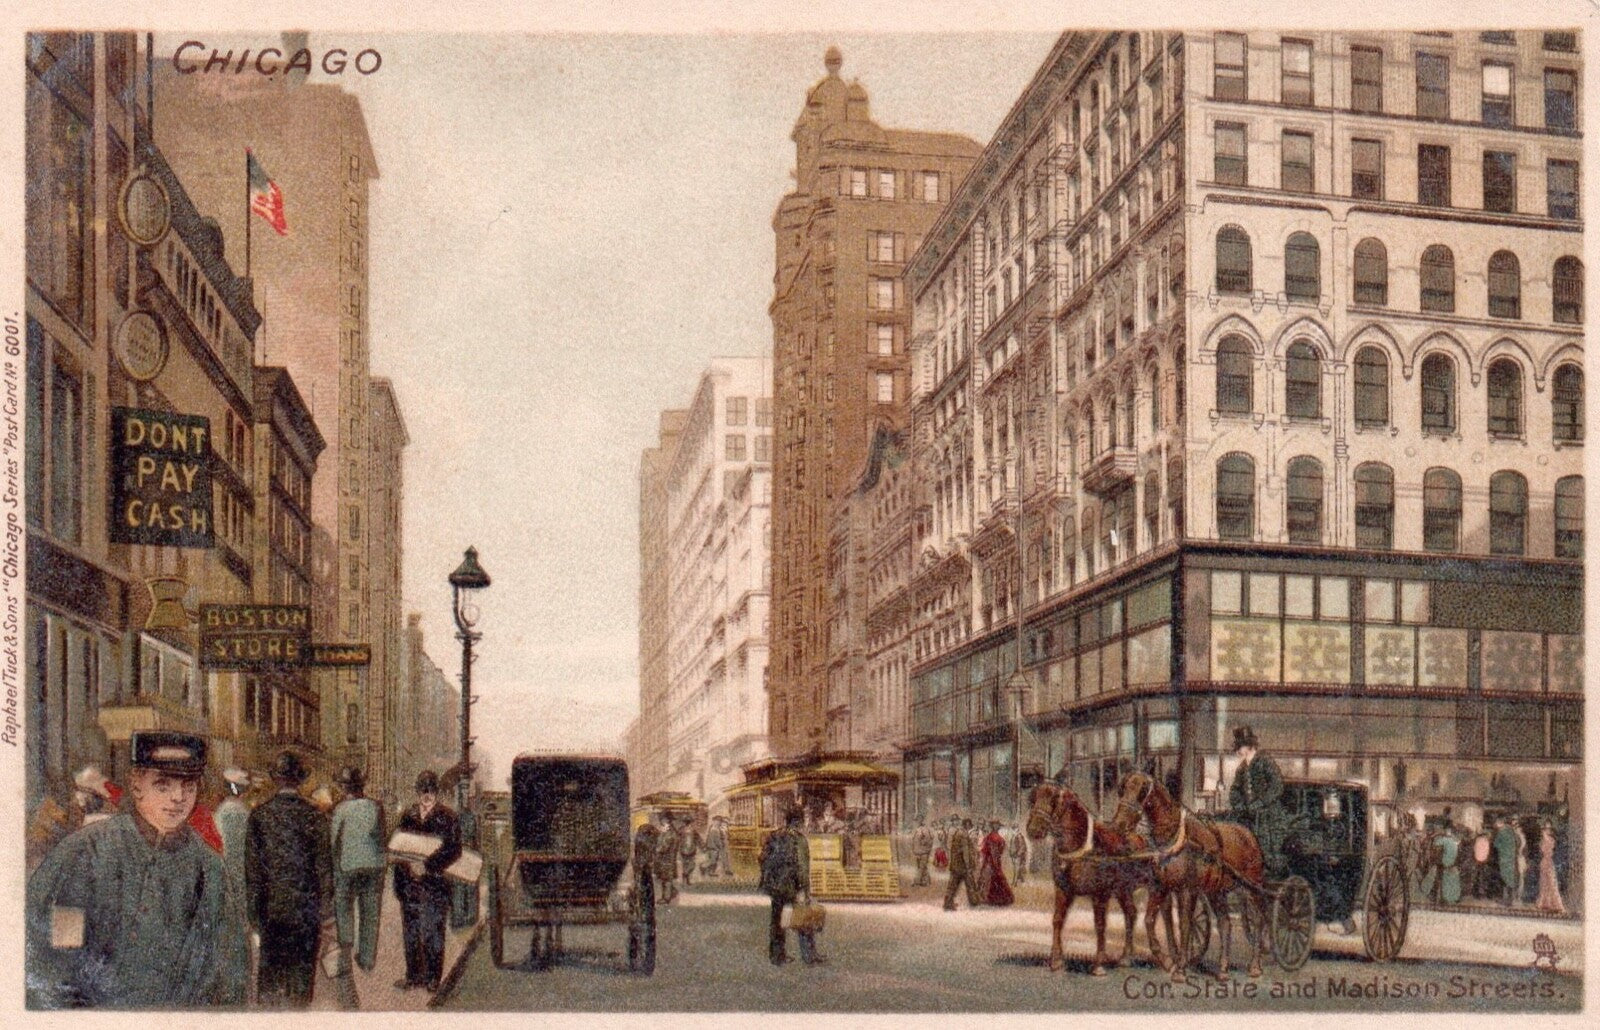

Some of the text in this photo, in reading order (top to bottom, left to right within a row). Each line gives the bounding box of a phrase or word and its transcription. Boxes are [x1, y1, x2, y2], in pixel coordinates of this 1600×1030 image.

[125, 418, 205, 454] DONT
[137, 456, 199, 493] PAY
[126, 500, 207, 534] CASH
[206, 608, 307, 627] BOSTON
[213, 638, 300, 656] STORE
